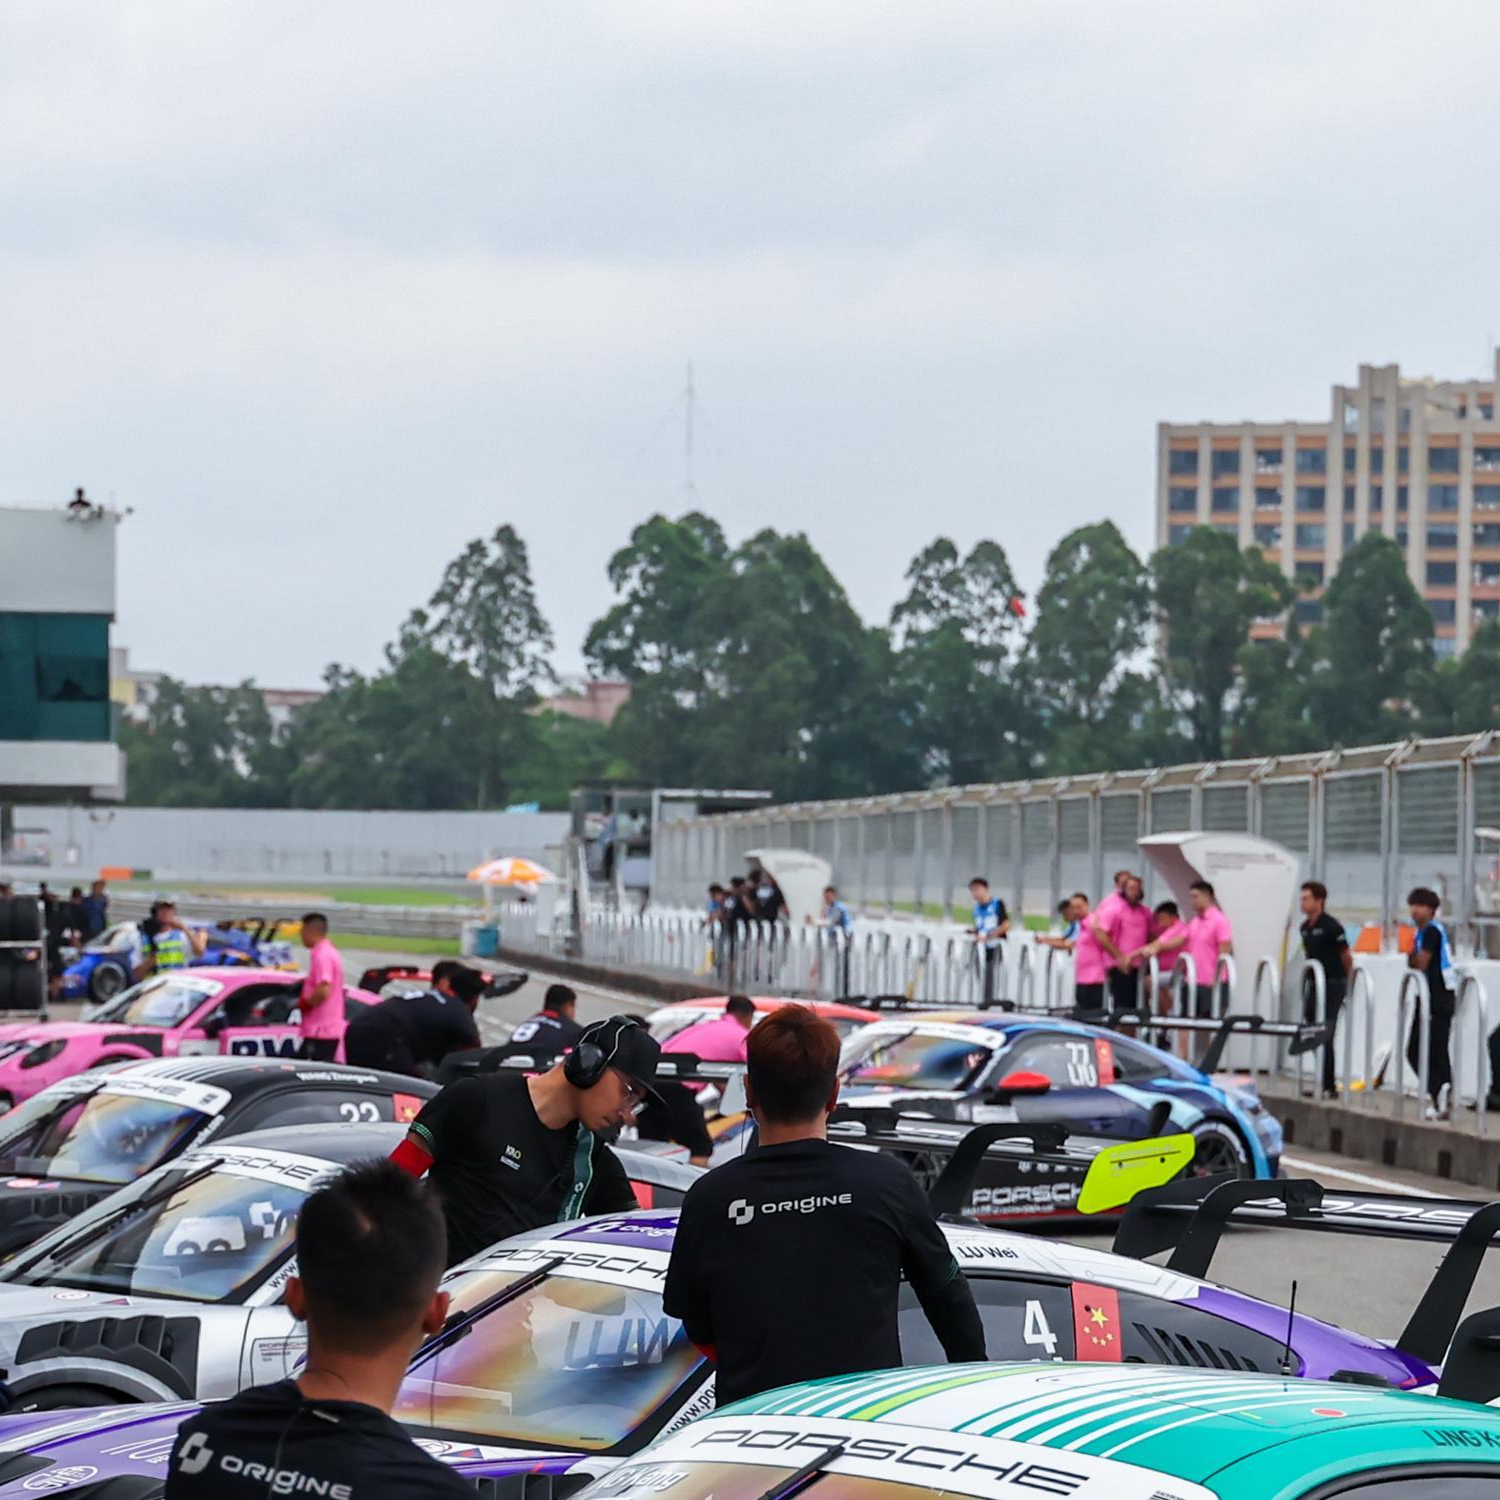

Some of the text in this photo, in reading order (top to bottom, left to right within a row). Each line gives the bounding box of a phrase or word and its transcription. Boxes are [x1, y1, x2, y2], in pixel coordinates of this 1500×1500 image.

[1064, 1042, 1090, 1065] 77
[1067, 1063, 1098, 1087] LIU
[960, 1245, 1019, 1260] LU Wei
[479, 1248, 670, 1281] PORSCH
[1023, 1299, 1058, 1354] 4
[258, 1342, 308, 1350] PORSCH
[1422, 1429, 1481, 1448] LING
[691, 1430, 1090, 1496] PORSCHE
